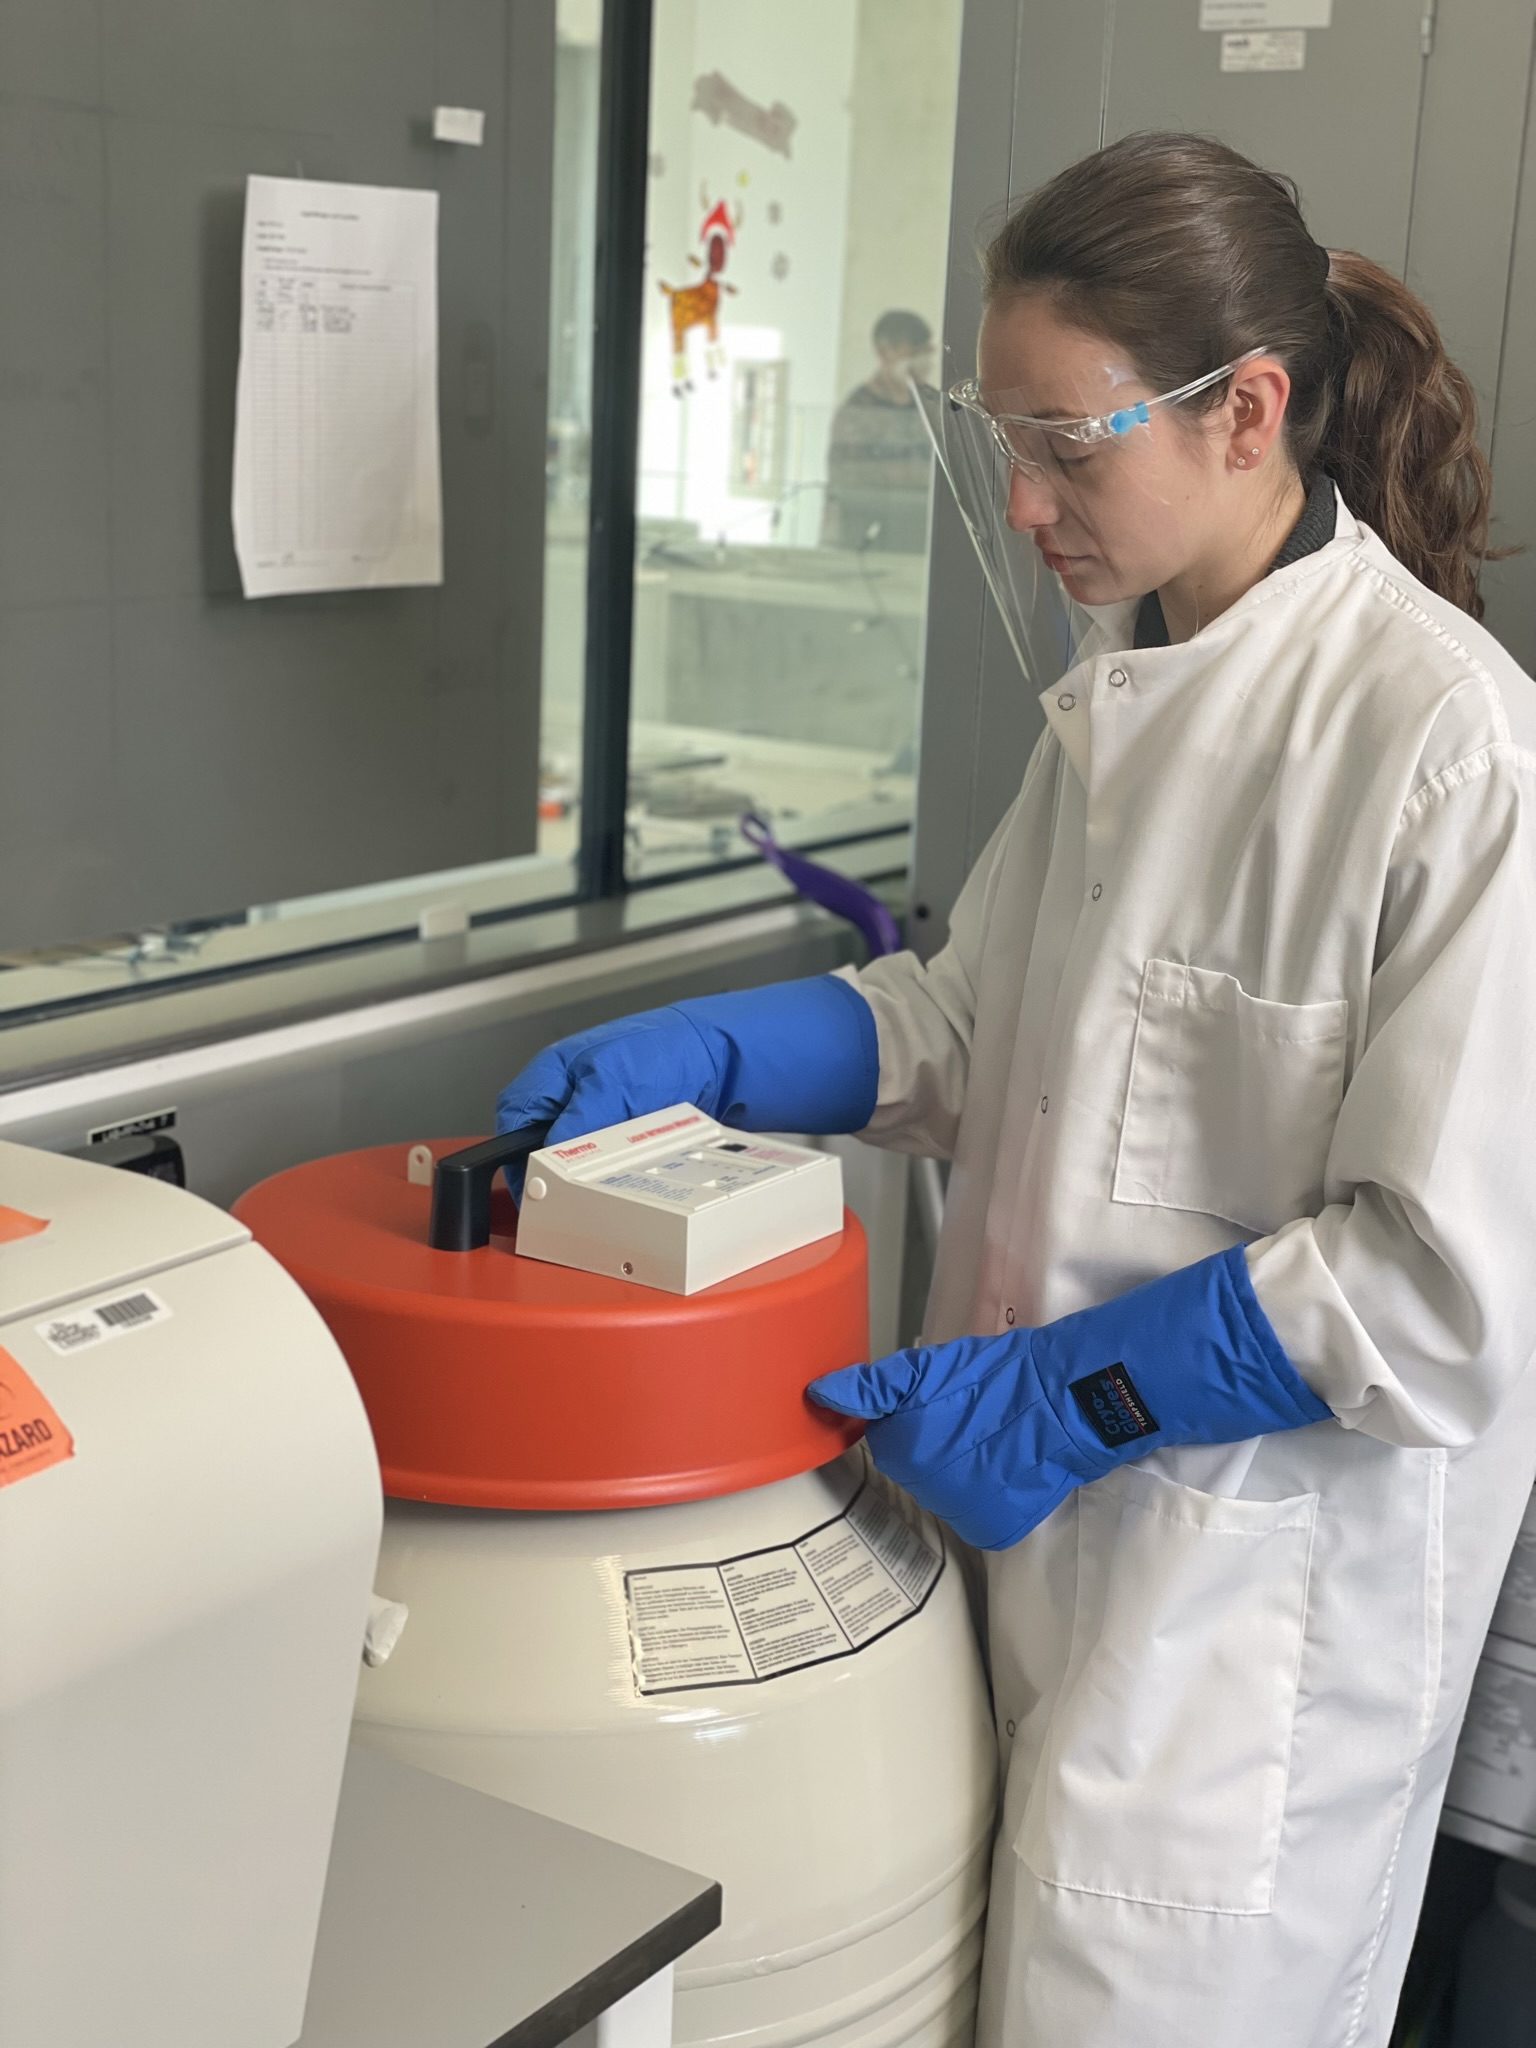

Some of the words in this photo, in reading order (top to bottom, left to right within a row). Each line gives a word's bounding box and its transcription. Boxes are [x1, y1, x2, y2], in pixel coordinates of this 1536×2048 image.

[552, 1142, 598, 1160] Thermo
[1100, 1379, 1139, 1434] Gloves
[1115, 1378, 1148, 1427] TEMPSHIELD
